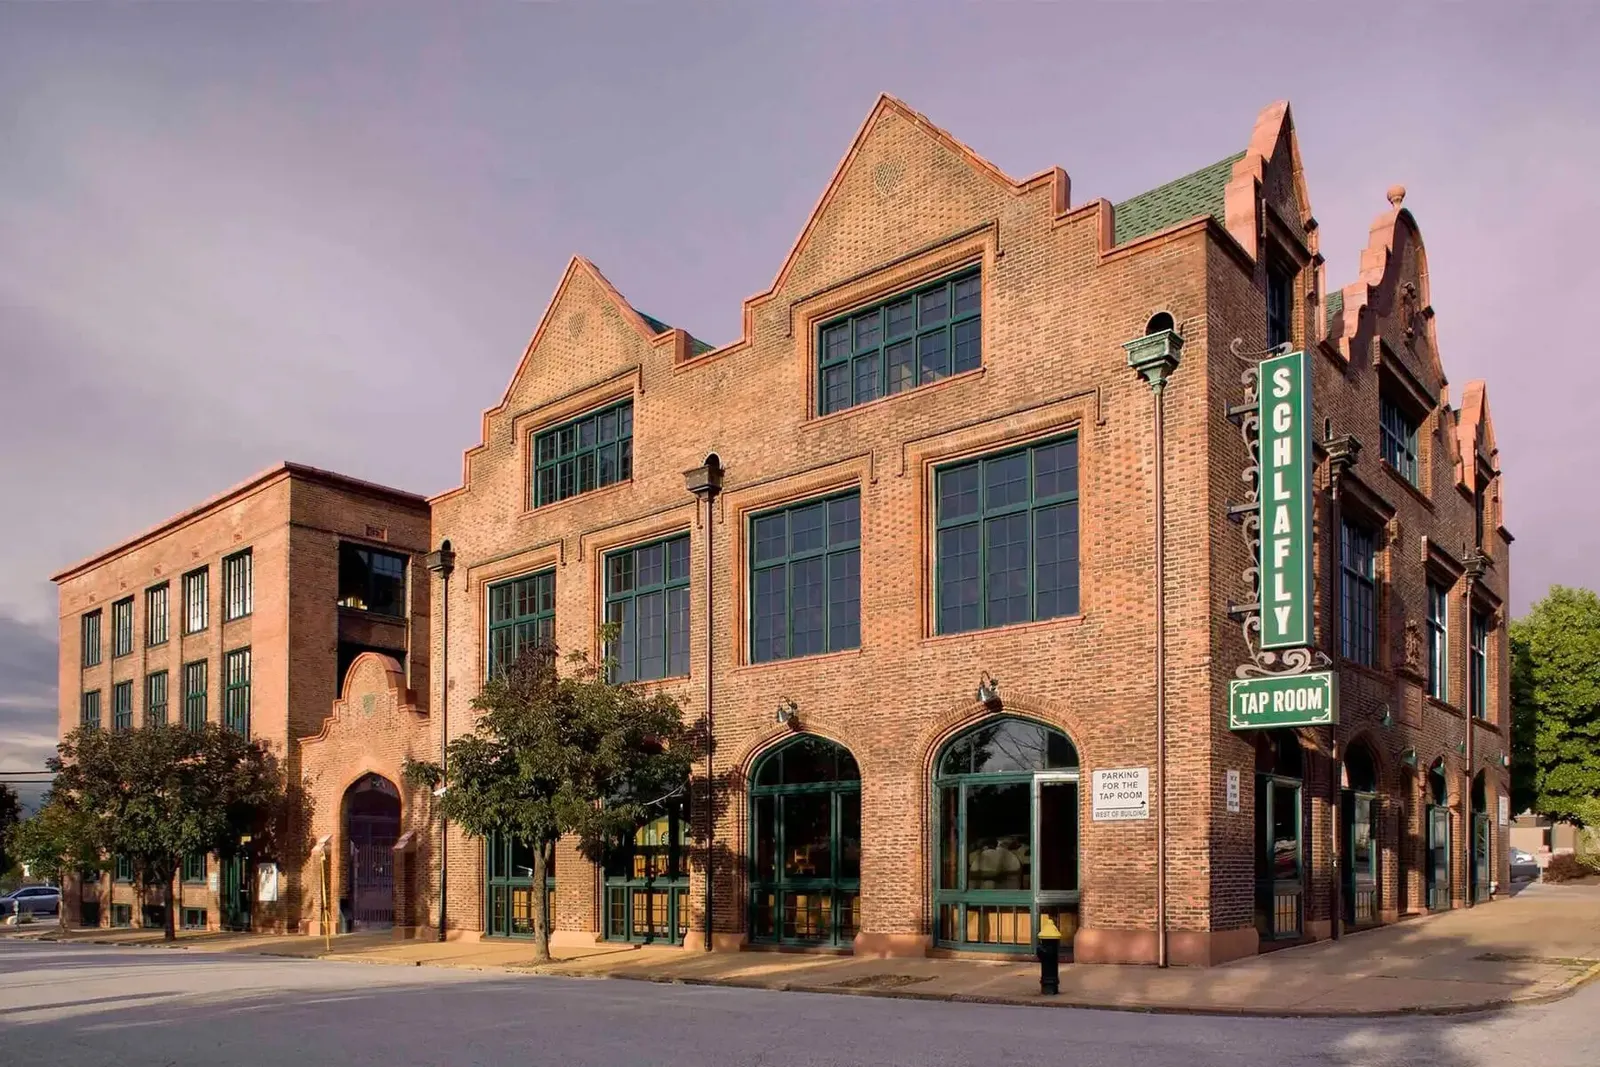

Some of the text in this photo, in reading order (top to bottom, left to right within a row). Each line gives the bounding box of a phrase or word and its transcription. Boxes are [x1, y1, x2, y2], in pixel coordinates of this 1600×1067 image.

[1273, 367, 1291, 635] SCHLAFLY
[1239, 687, 1322, 715] TAP ROOM
[1101, 771, 1139, 780] PARKING
[1102, 781, 1138, 790] FOR THE
[1099, 791, 1143, 800] TAP ROOM
